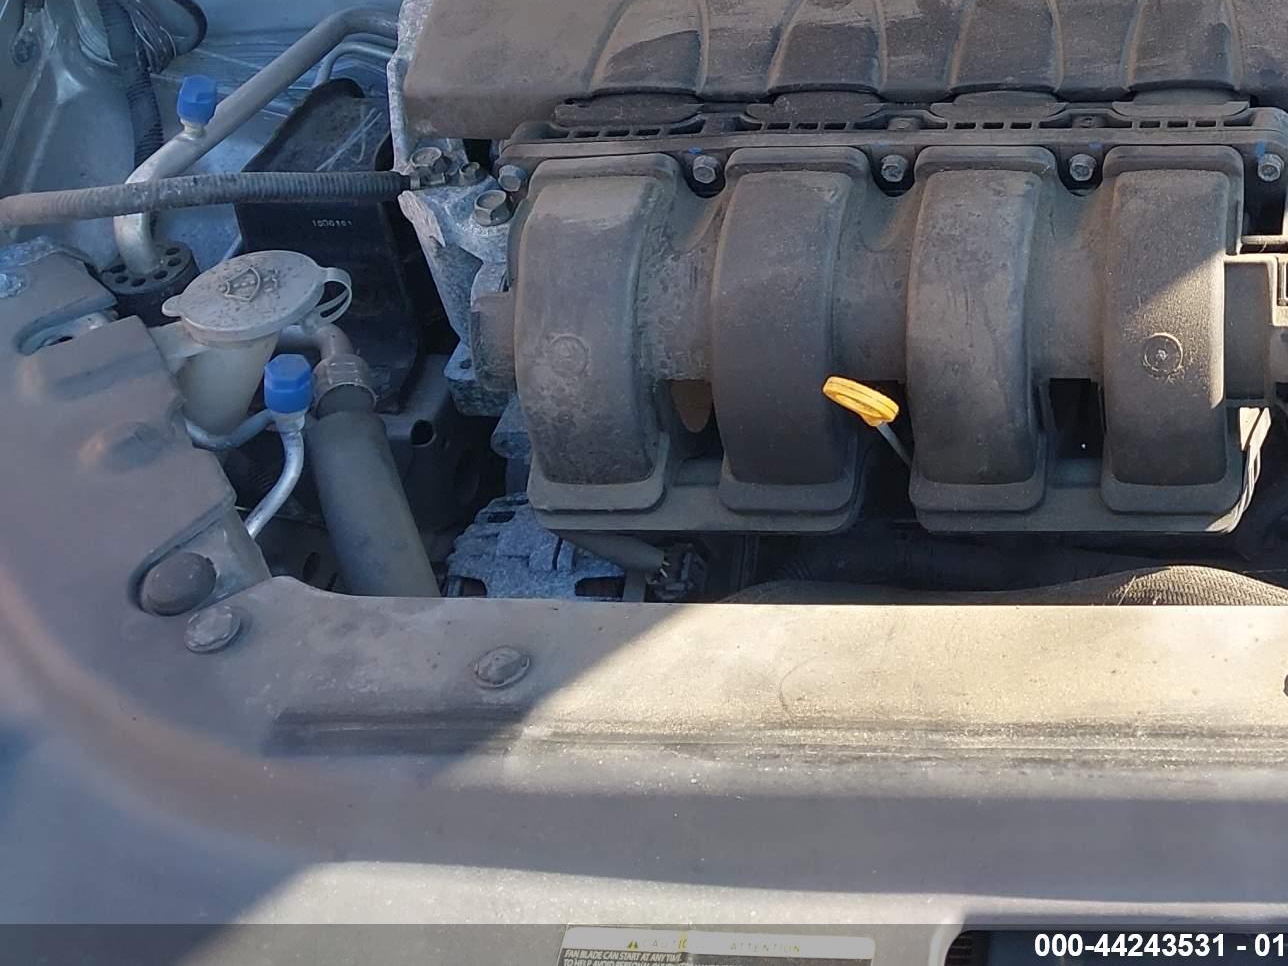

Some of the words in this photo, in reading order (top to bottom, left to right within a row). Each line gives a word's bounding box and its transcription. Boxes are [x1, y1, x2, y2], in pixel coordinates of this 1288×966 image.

[564, 950, 579, 958] FAN
[579, 950, 602, 959] BLADE
[602, 951, 619, 959] CAN
[619, 951, 641, 960] START
[640, 952, 651, 961] AT
